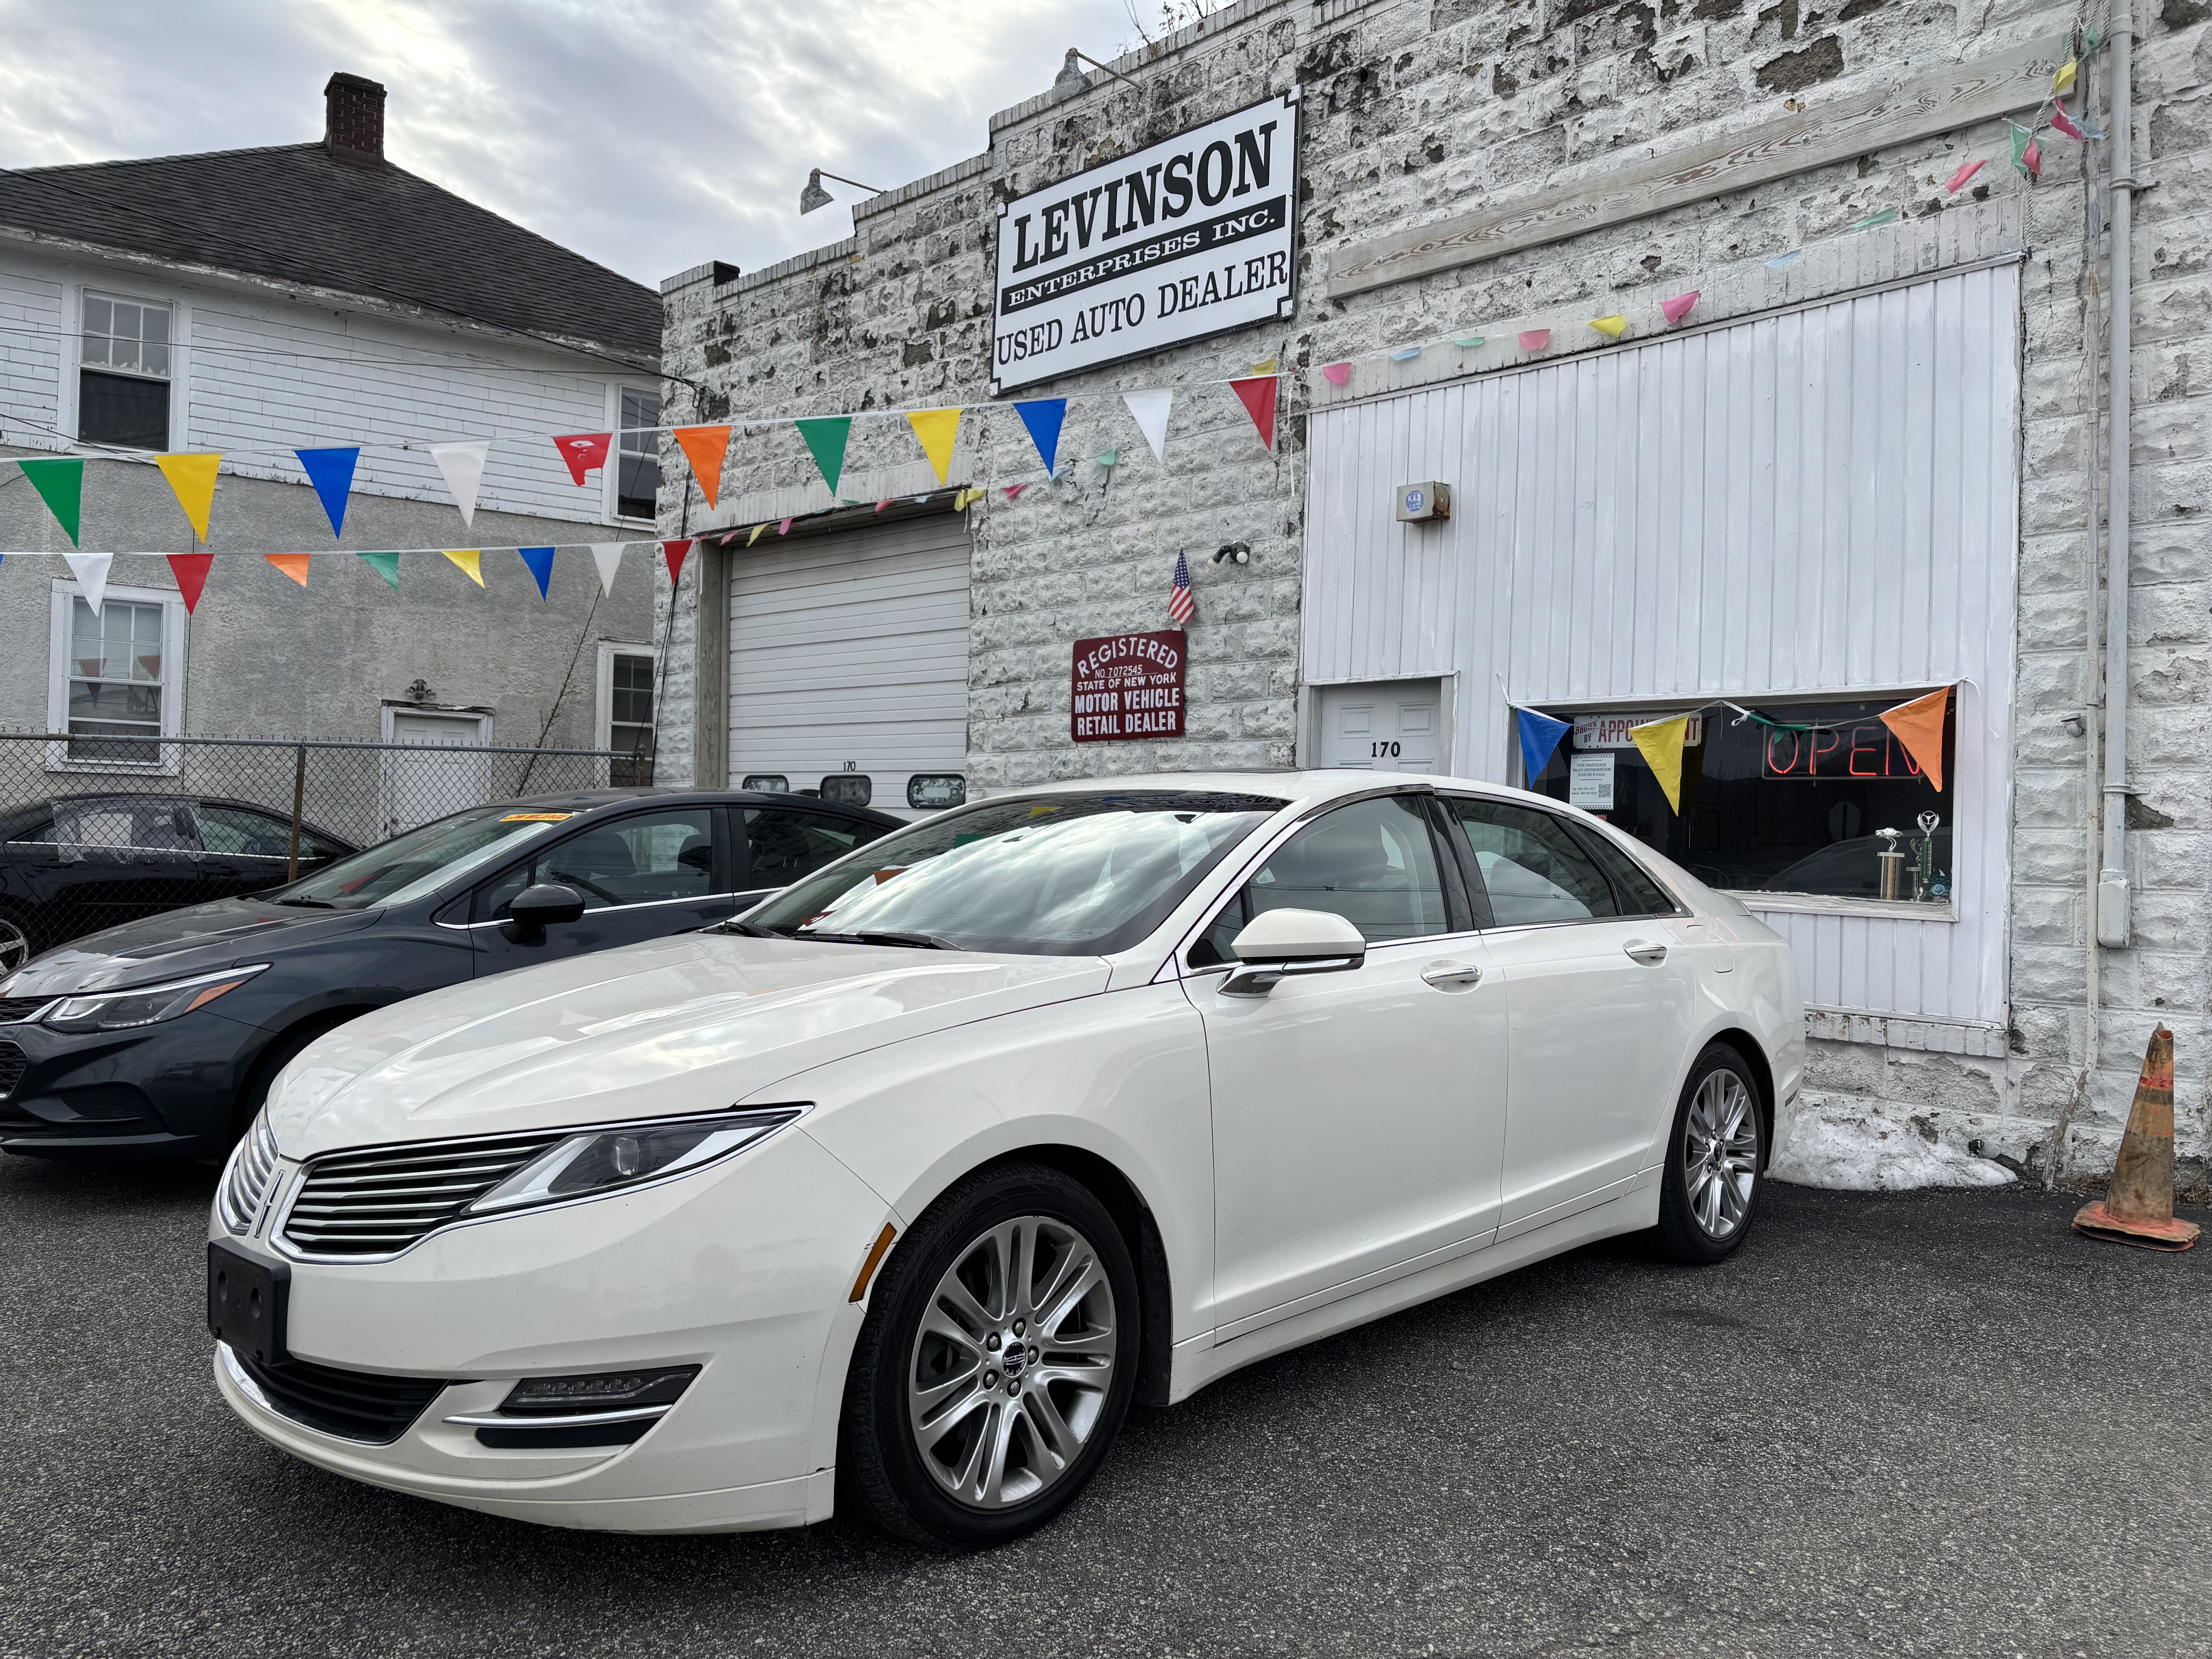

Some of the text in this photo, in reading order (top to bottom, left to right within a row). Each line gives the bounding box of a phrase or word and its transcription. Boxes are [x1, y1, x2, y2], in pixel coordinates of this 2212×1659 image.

[1012, 120, 1277, 273] LEVINSON
[1008, 209, 1276, 307] ENTERPRISES INC.
[997, 250, 1288, 365] USED AUTO DEALER
[1077, 637, 1178, 678] REGISTERED
[1077, 672, 1176, 691] STATE OF NEW YORK
[1095, 664, 1142, 678] NO. 7072545
[1075, 688, 1180, 713] MOTOR VEHICLE
[1077, 711, 1176, 736] RETAIL DEALER
[1576, 720, 1597, 735] SHOWN
[1371, 741, 1401, 757] 170
[1584, 733, 1592, 743] BY
[1768, 726, 1920, 775] OPEN
[843, 761, 856, 771] 170
[936, 1208, 975, 1249] OUTSIDE
